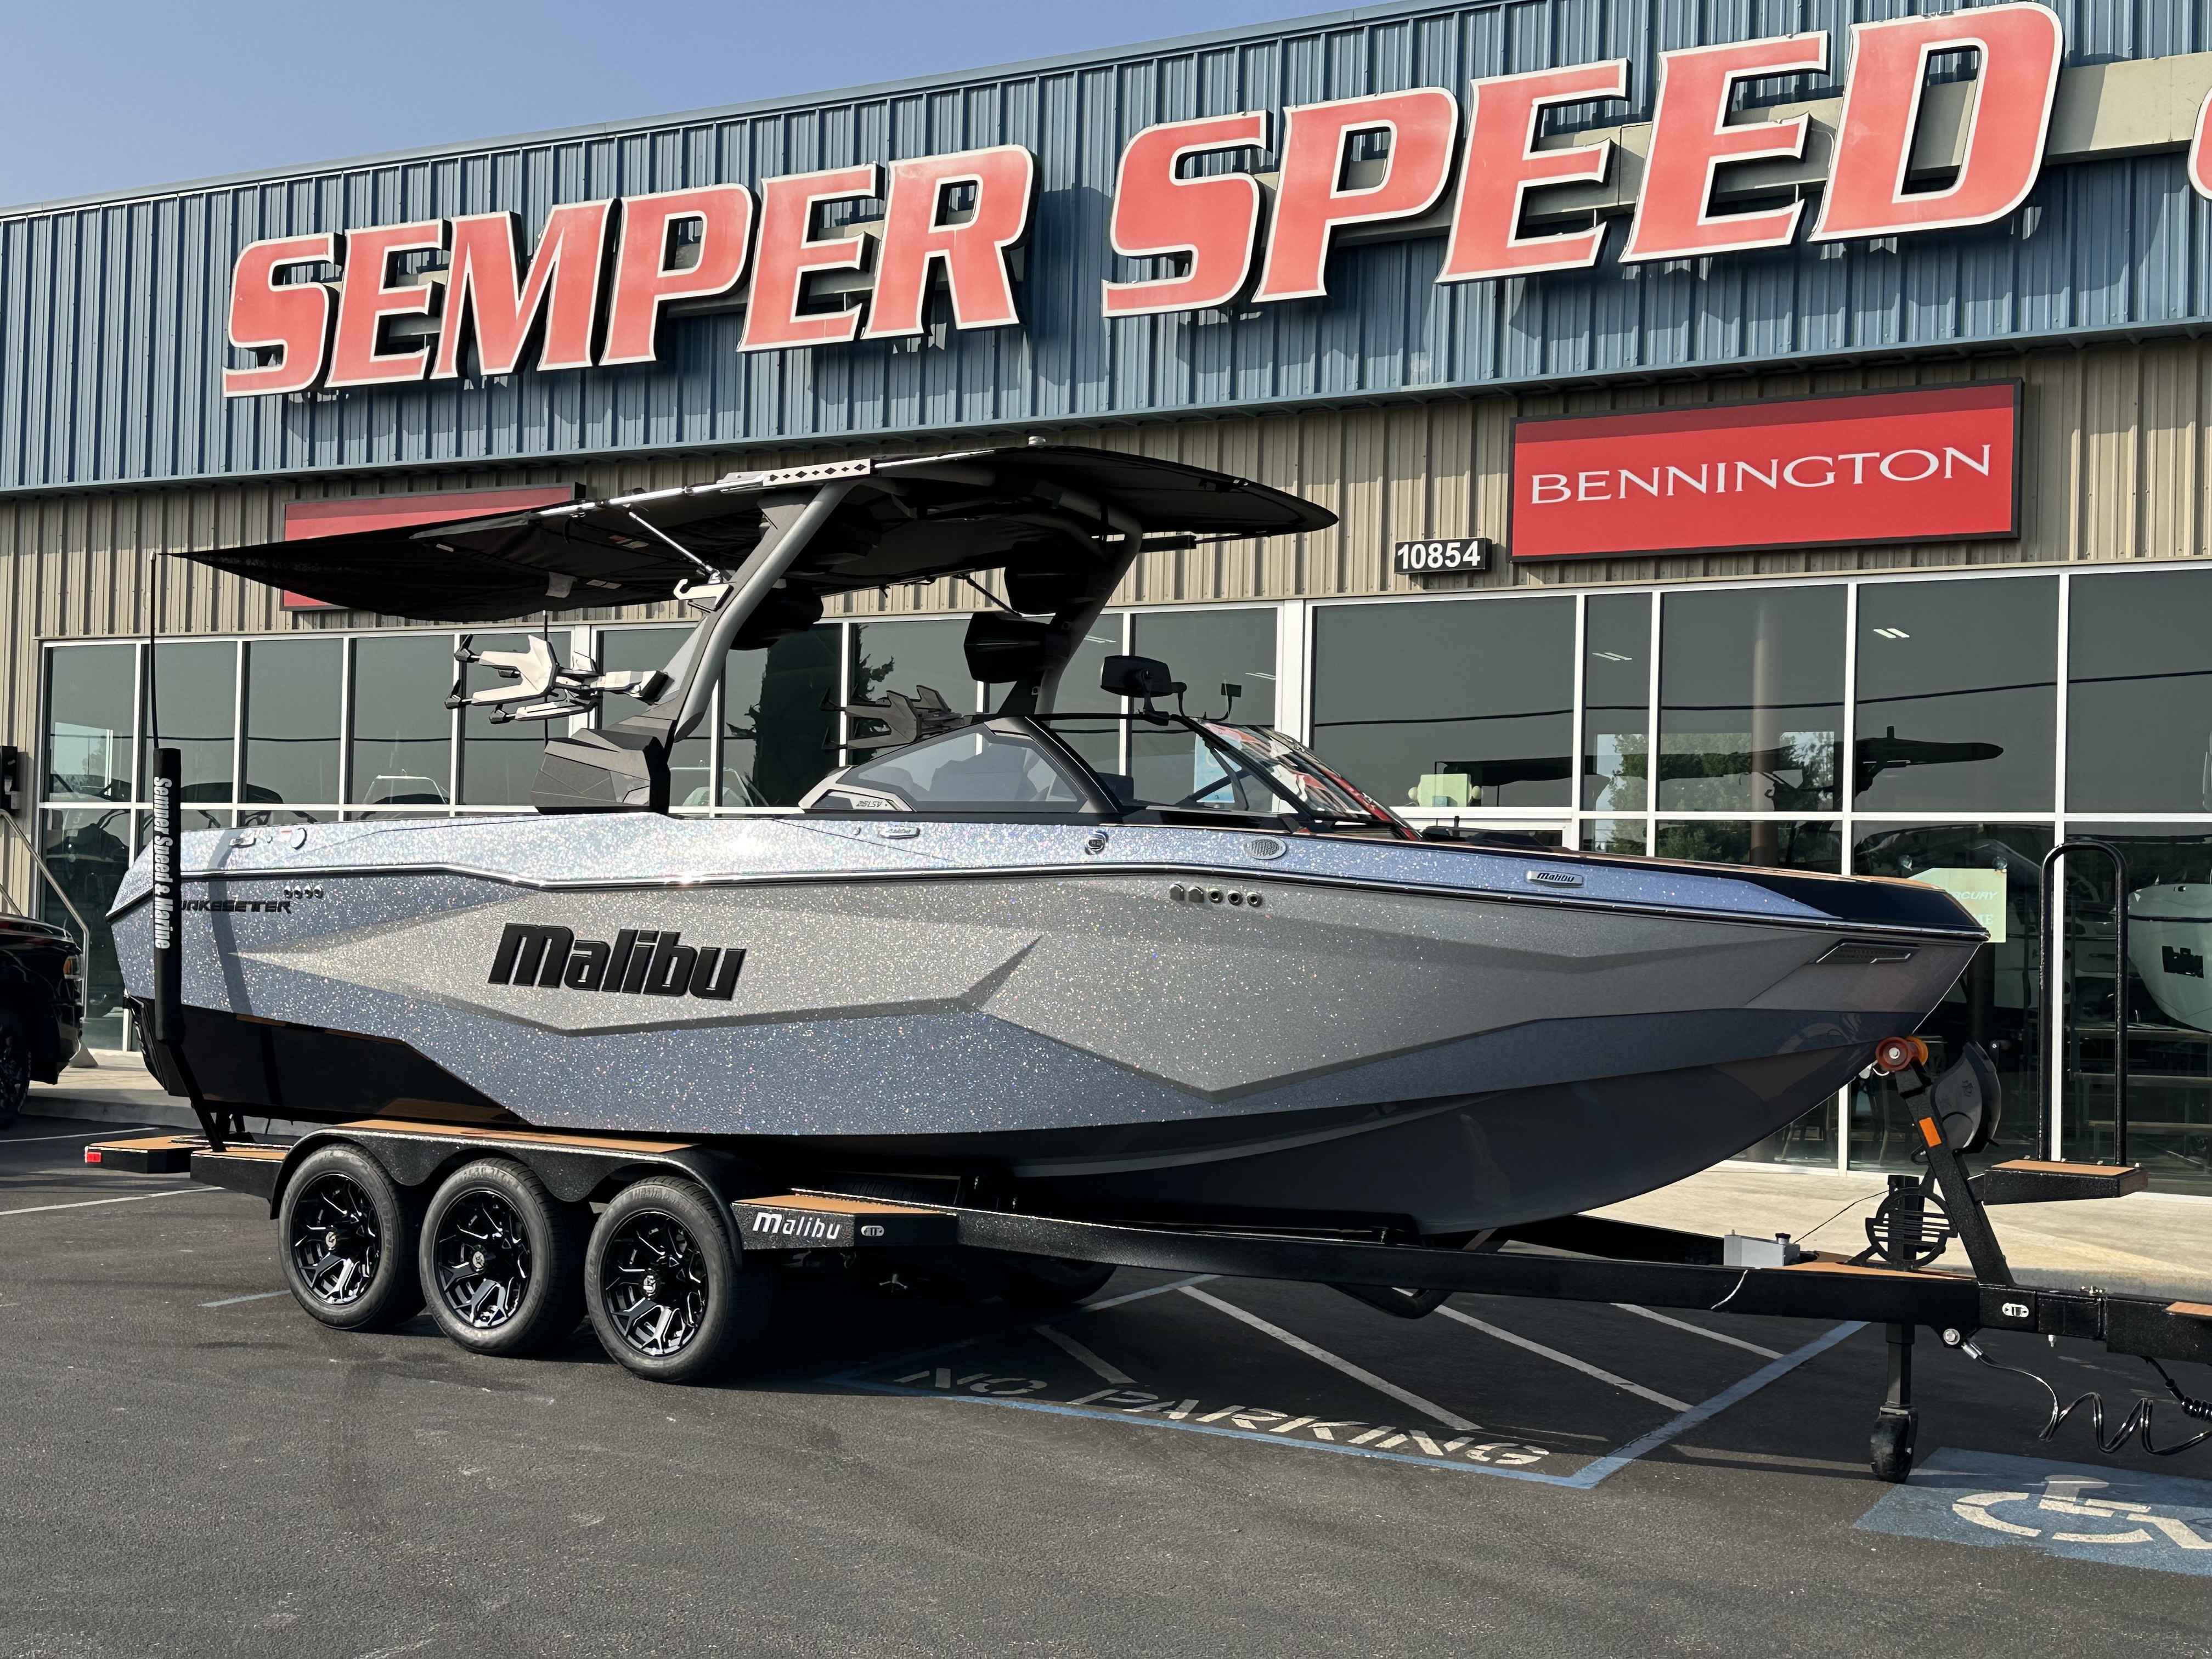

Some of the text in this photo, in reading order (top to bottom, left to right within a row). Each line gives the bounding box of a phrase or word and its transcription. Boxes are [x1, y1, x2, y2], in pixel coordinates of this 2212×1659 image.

[223, 144, 1036, 398] SEMPER
[1102, 1, 2064, 318] SPEED
[1531, 444, 1991, 504] BENNINGTON
[1397, 540, 1481, 569] 10854
[154, 883, 171, 895] &
[1536, 872, 1575, 882] Malibu
[154, 896, 174, 949] Marine
[488, 922, 747, 1001] Malibu
[752, 1211, 841, 1239] Malibu
[894, 1368, 1550, 1465] NO PARKING
